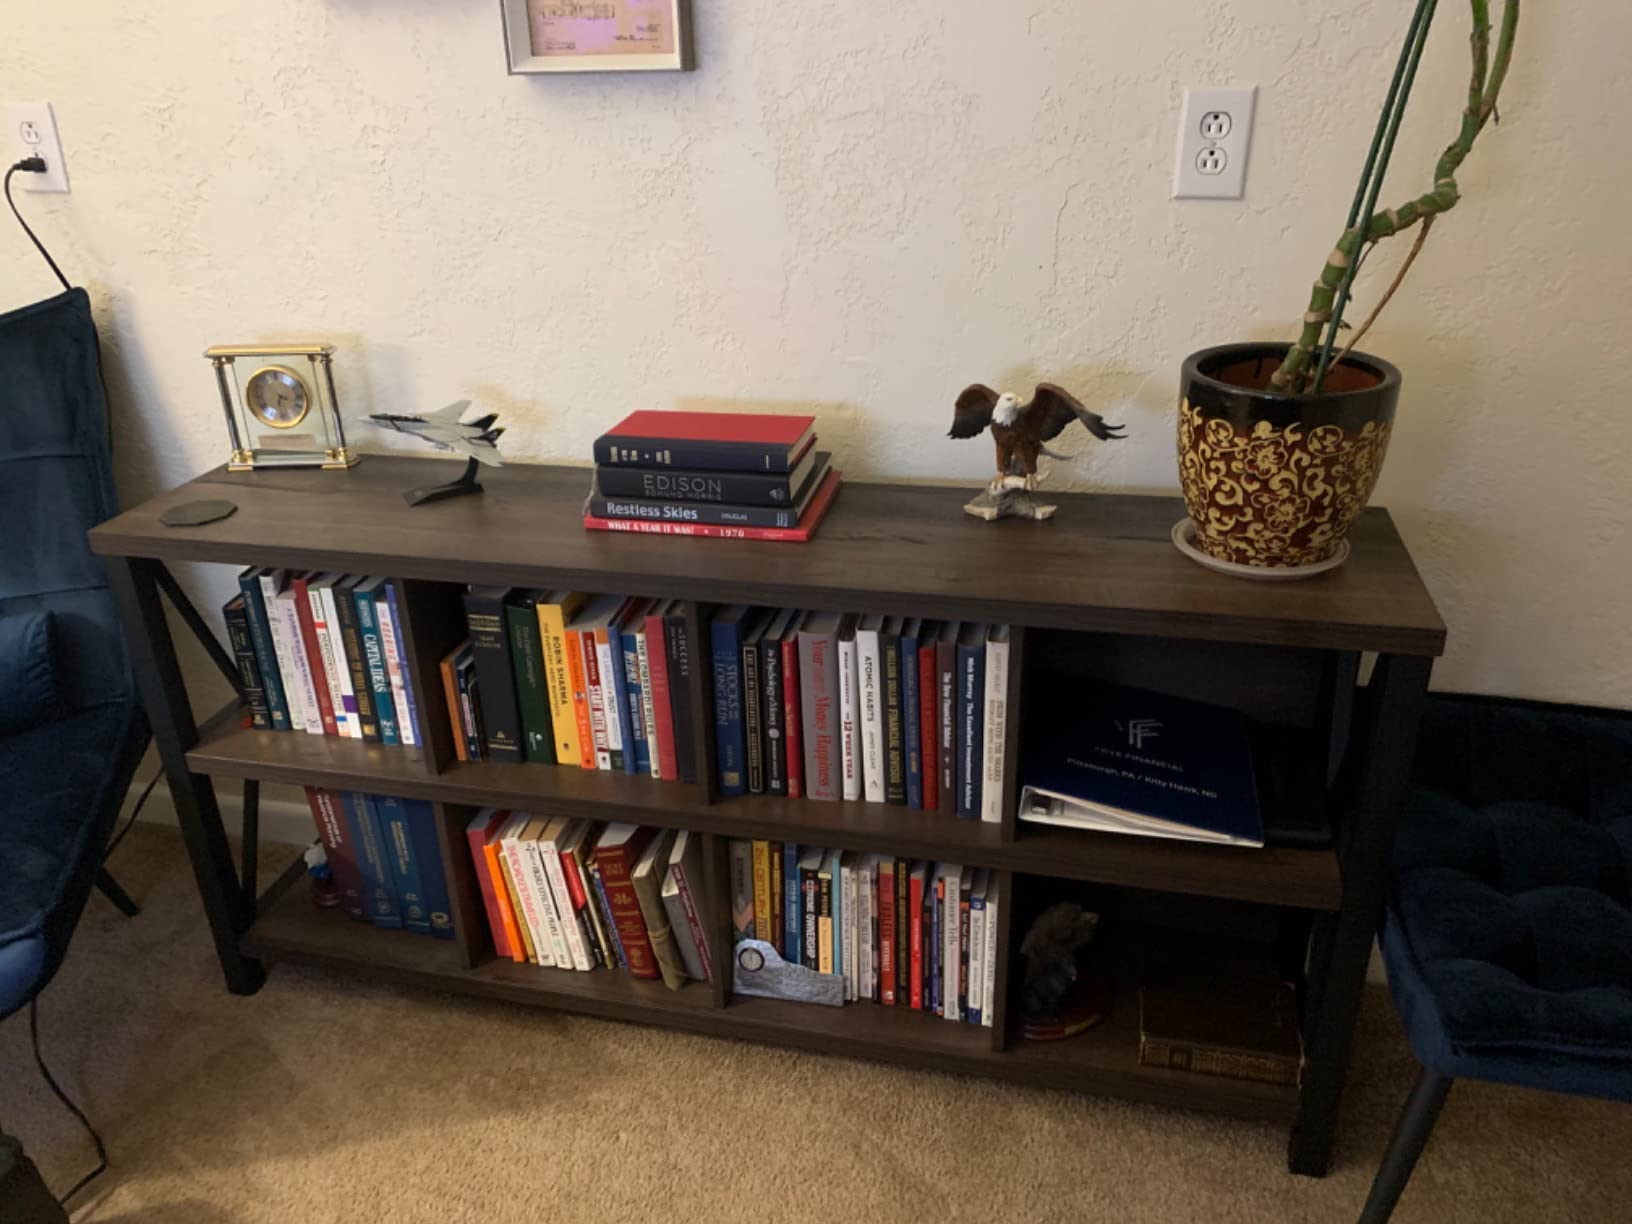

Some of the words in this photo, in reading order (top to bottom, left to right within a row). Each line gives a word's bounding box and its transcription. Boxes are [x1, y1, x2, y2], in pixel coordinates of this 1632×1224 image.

[643, 474, 722, 493] EDISON
[607, 502, 660, 517] Restless
[663, 506, 698, 520] Skies
[607, 521, 631, 531] WHAT
[641, 523, 662, 533] YEAR
[663, 524, 670, 533] IT
[720, 528, 745, 538] 1970
[364, 632, 381, 667] CAPITAL
[553, 635, 563, 665] ROBIN
[678, 634, 689, 676] SUCCESS
[812, 639, 829, 666] Your
[371, 667, 387, 694] IDEAS
[557, 667, 568, 705] SHARMA
[726, 663, 739, 708] STOCKS
[764, 657, 778, 696] Psychology
[864, 656, 873, 688] ATOMIC
[589, 685, 602, 709] START
[966, 674, 974, 699] Murray
[718, 700, 728, 726] RUN
[767, 701, 777, 726] Money
[813, 694, 832, 731] Money
[866, 691, 874, 722] HABITS
[844, 720, 853, 732] 12
[888, 709, 899, 748] FINANCIAL
[814, 735, 834, 786] Happiness
[1124, 752, 1184, 773] FINANCIAL
[1121, 770, 1136, 780] PA
[1144, 776, 1168, 788] Kitty
[756, 868, 766, 916] CENTURY
[806, 880, 814, 912] EXTREME
[949, 881, 958, 924] Customer
[547, 917, 559, 937] PEOPLE
[806, 914, 815, 959] OWNERSHIP
[949, 927, 958, 945] Tells
